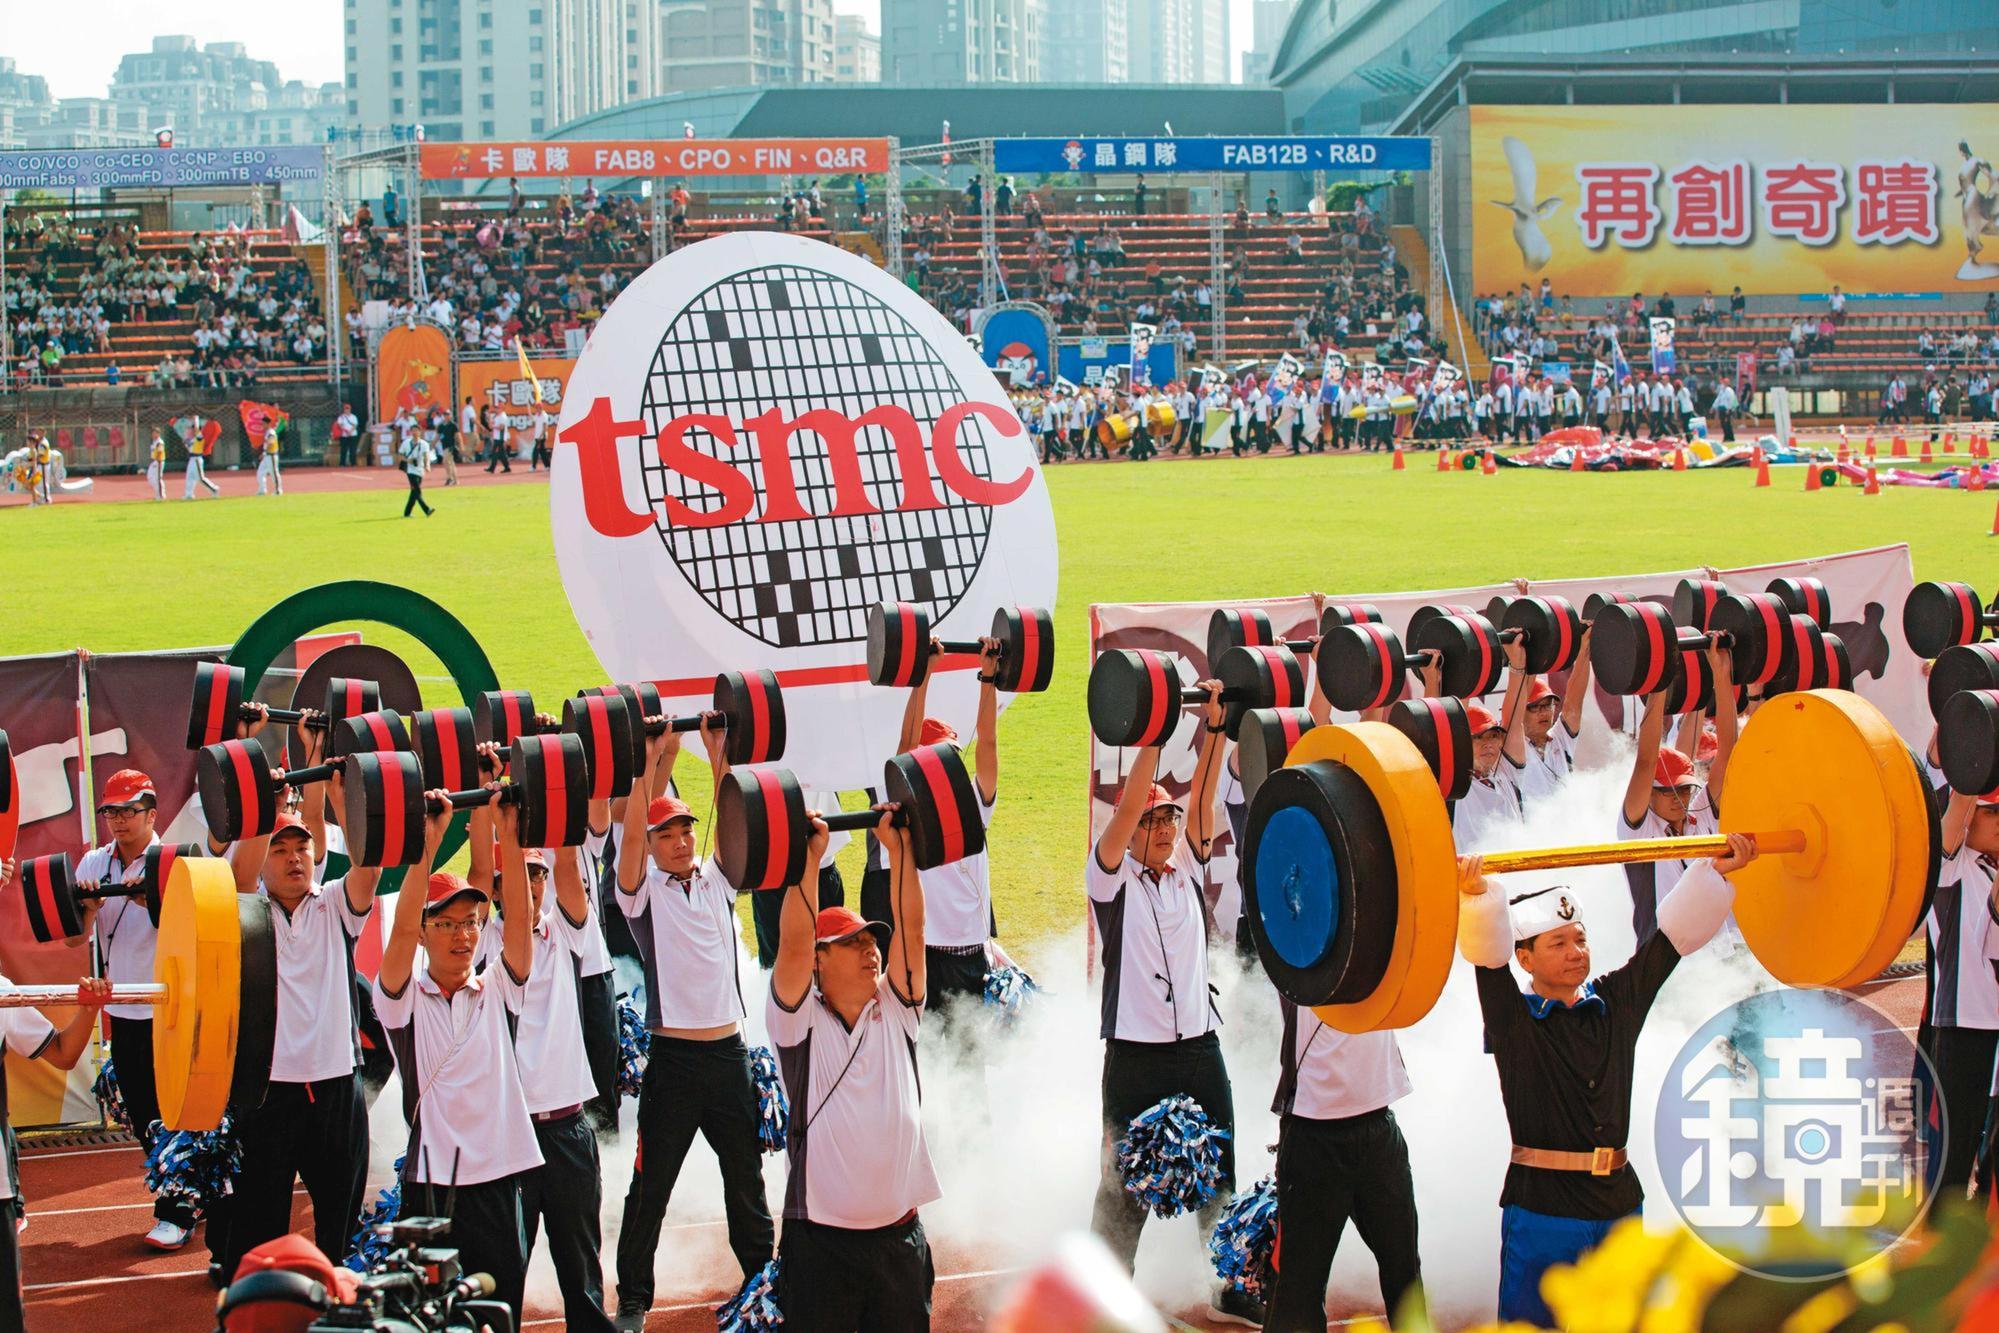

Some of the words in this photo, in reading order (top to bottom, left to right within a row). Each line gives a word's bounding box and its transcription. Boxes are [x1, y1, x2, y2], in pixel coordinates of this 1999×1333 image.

[480, 146, 569, 173] 卡歐隊
[815, 147, 868, 169] Q&R
[1329, 143, 1377, 164] R&D
[1576, 159, 1936, 243] 再創奇蹟
[559, 396, 1035, 538] tsmc
